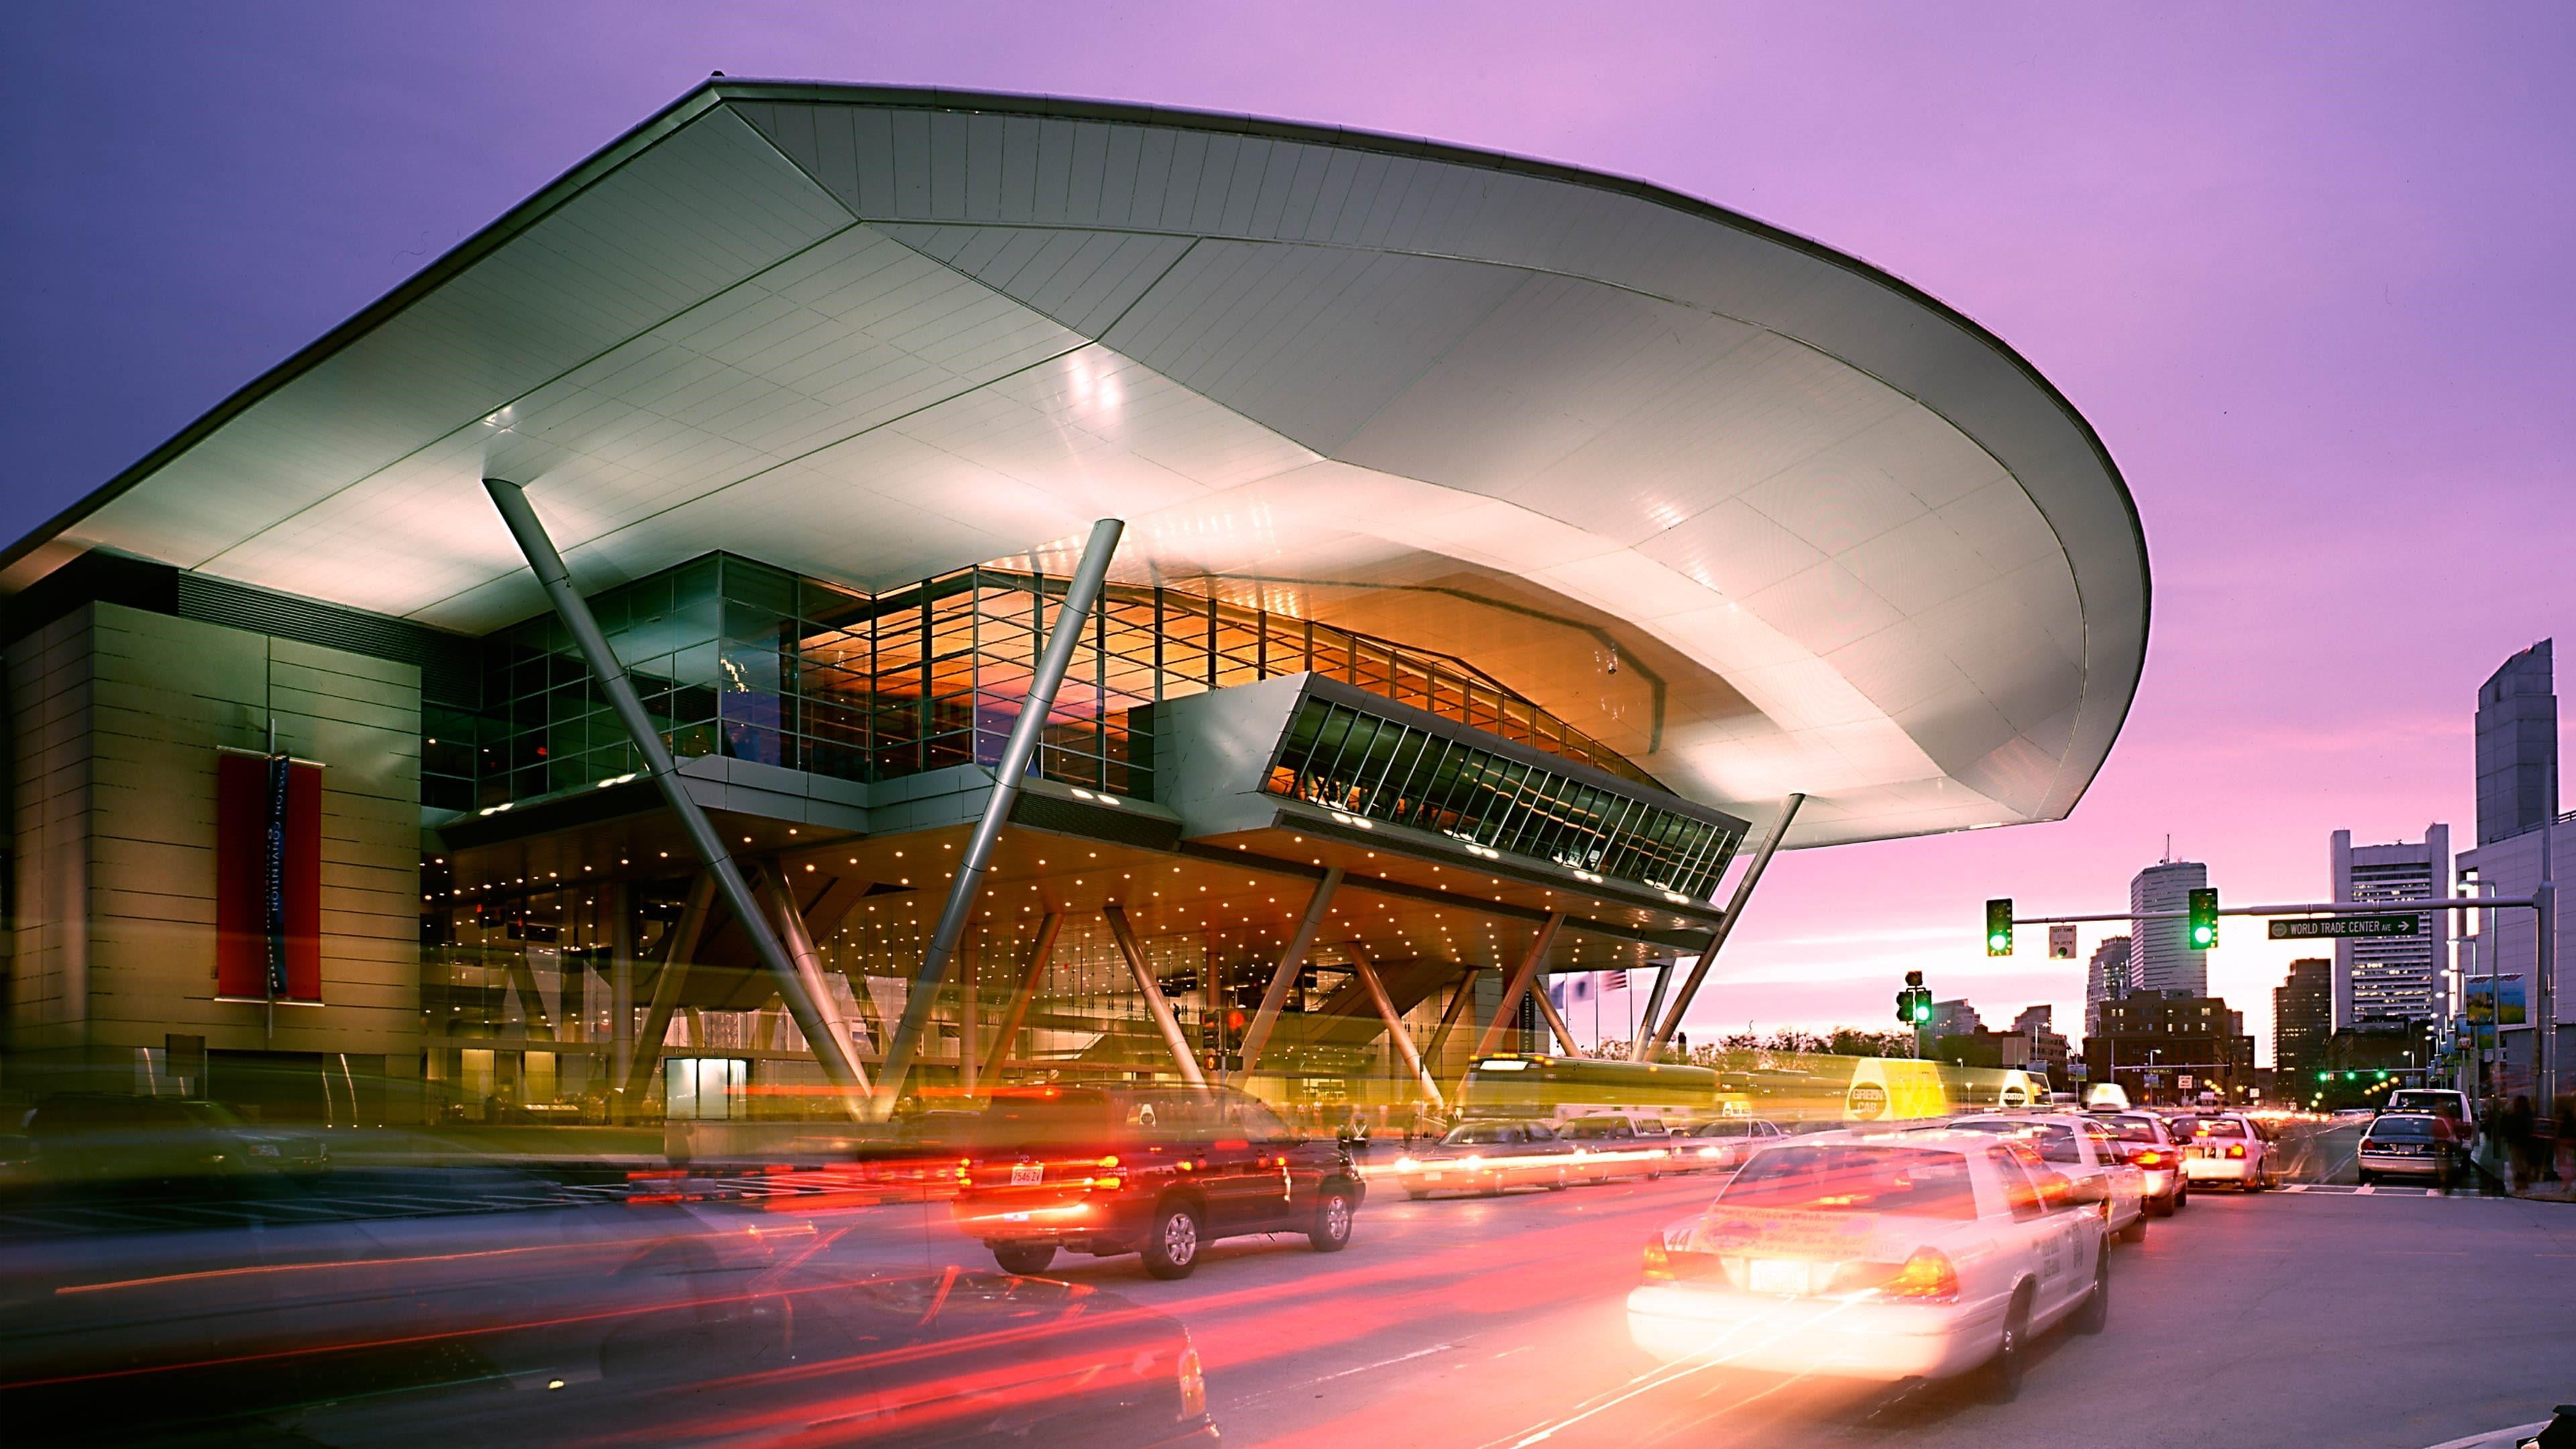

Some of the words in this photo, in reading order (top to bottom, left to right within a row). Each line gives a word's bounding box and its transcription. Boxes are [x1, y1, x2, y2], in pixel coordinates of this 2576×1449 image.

[272, 822, 281, 911] CONVENTION
[2290, 923, 2318, 935] WORLD
[2320, 922, 2346, 934] TRADE
[2348, 921, 2380, 932] CENTER
[2381, 924, 2392, 932] AVE
[1852, 1089, 1884, 1101] GREEN
[1858, 1102, 1877, 1113] CAB
[1668, 1230, 1692, 1245] 44
